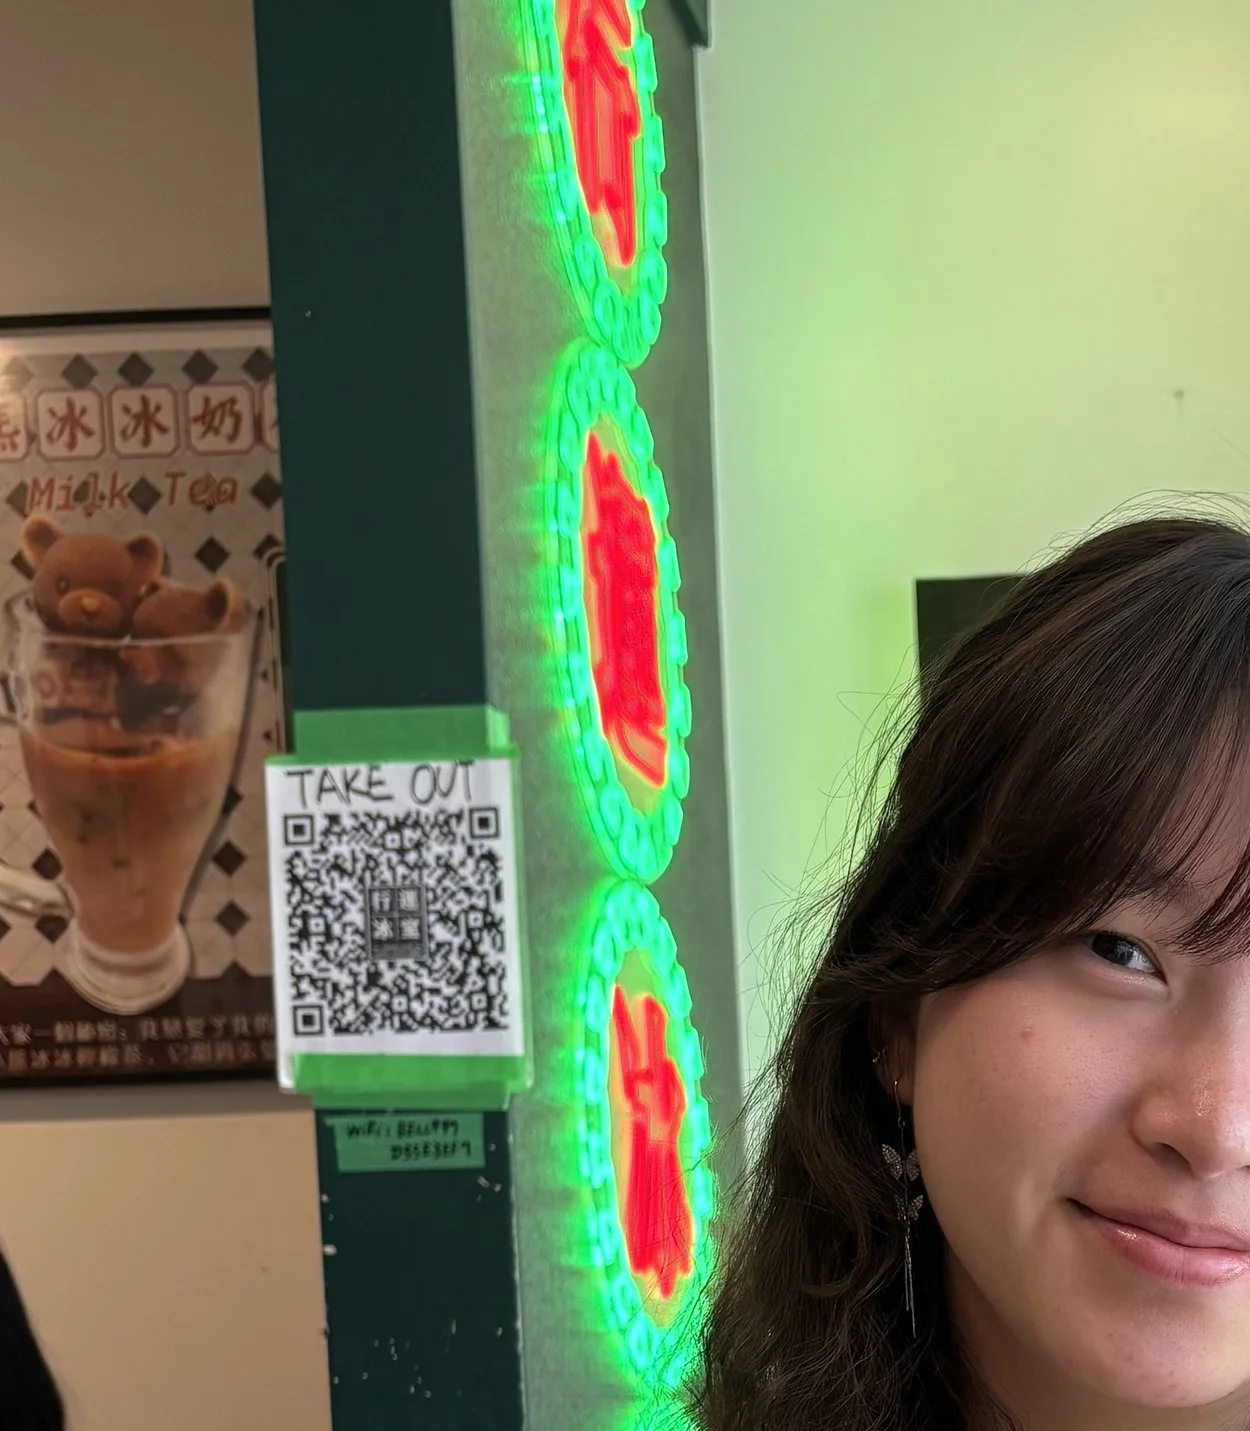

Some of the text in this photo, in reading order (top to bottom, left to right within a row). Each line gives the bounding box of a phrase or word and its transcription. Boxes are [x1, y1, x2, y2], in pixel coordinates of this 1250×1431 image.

[26, 470, 239, 513] Milk Tea
[284, 759, 476, 810] TAKE OUT
